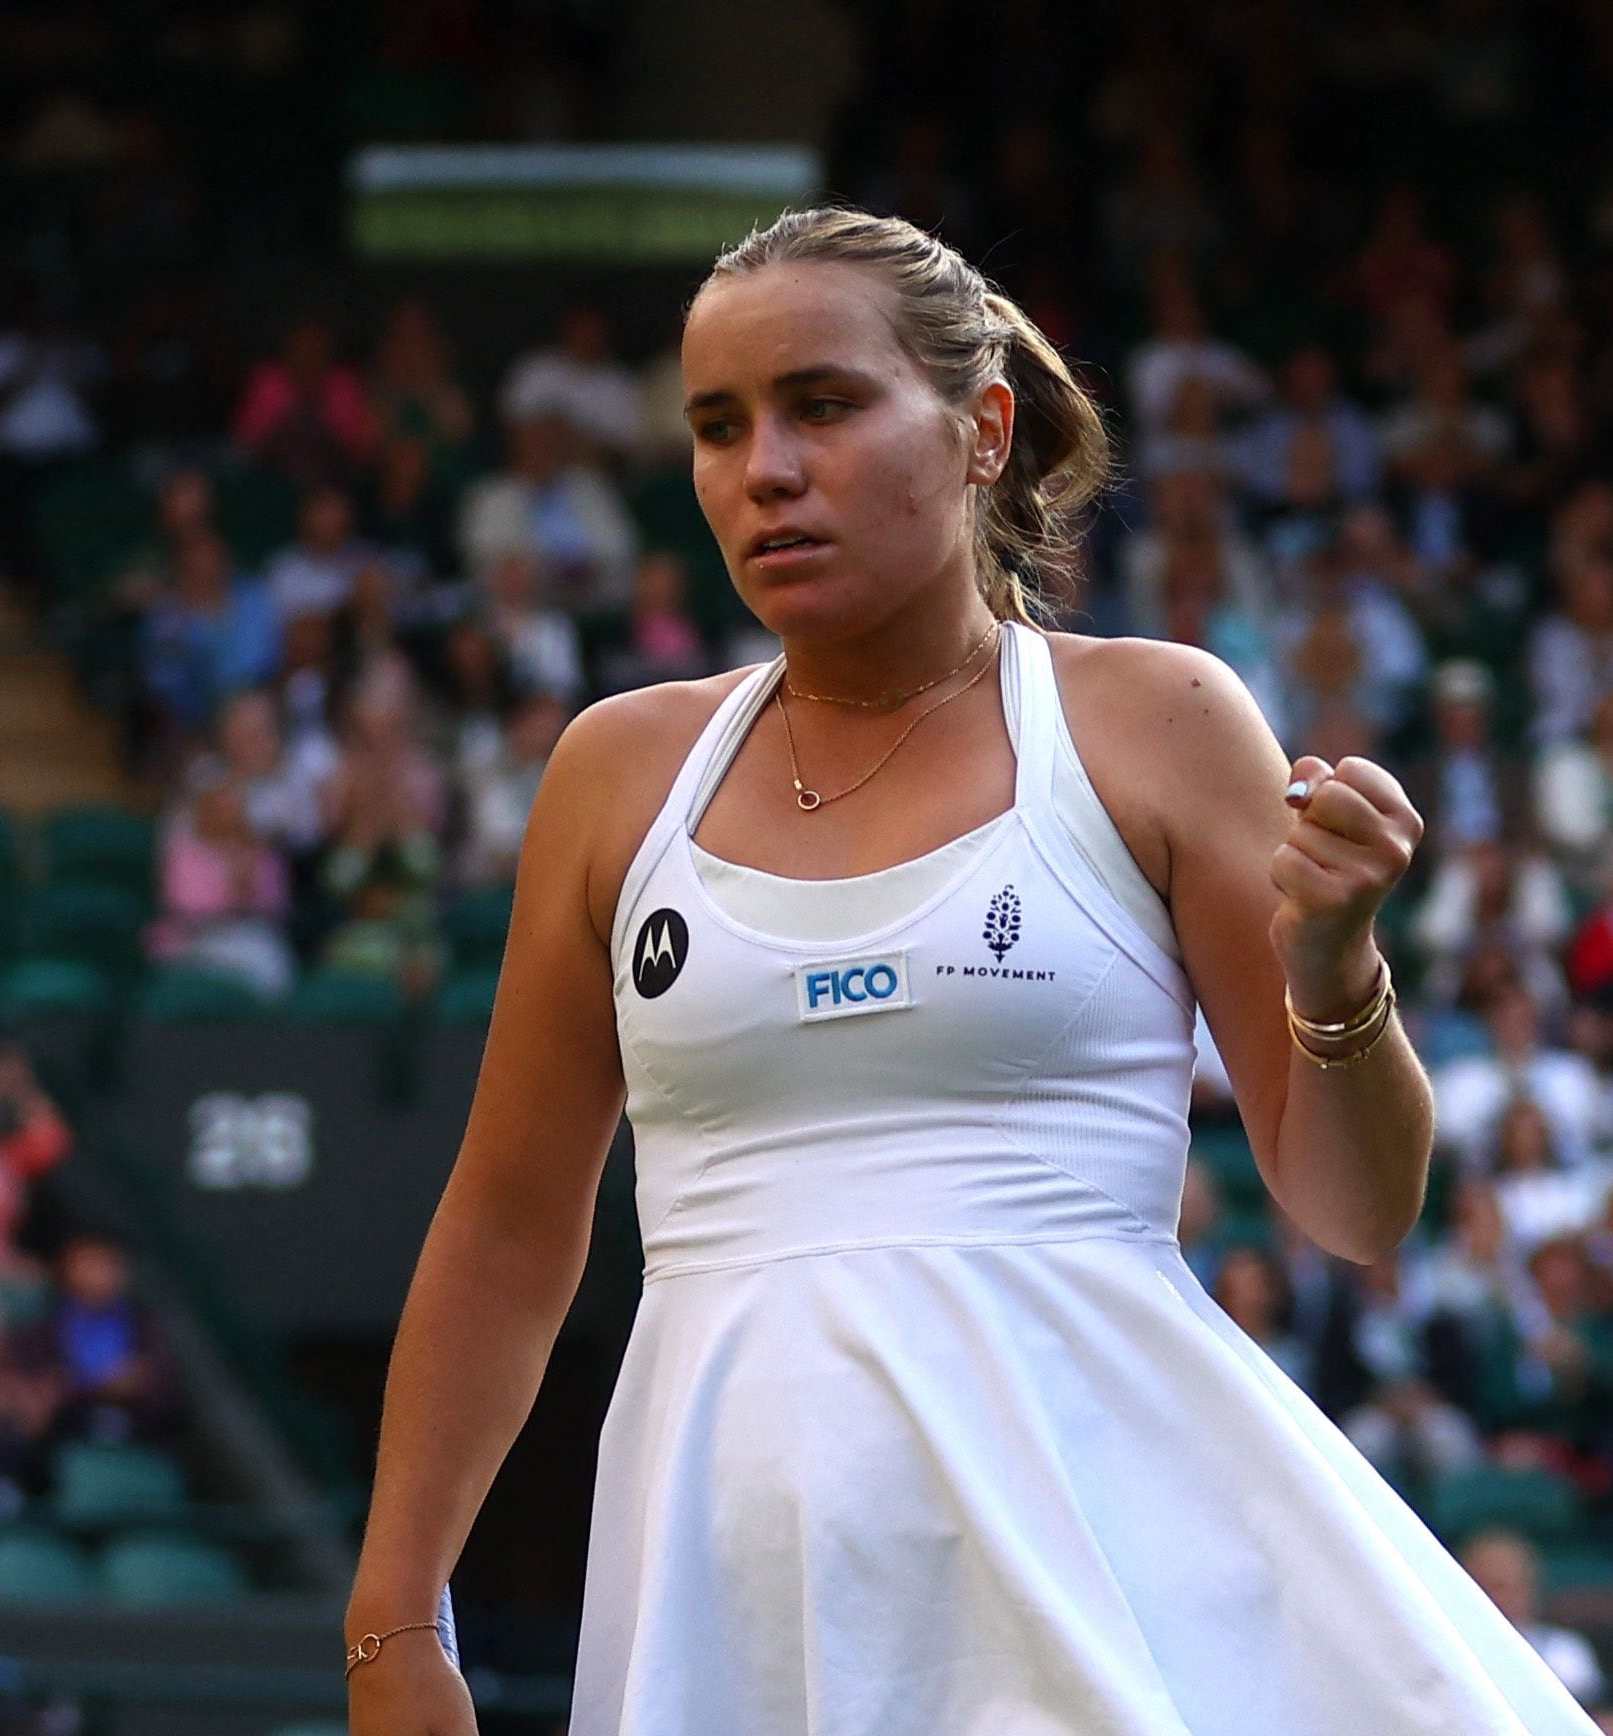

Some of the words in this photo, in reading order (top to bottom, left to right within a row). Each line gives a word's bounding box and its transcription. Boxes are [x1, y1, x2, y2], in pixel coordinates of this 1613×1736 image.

[807, 964, 898, 1008] FICO
[936, 965, 955, 976] FP
[963, 966, 1056, 981] MOVEMENT
